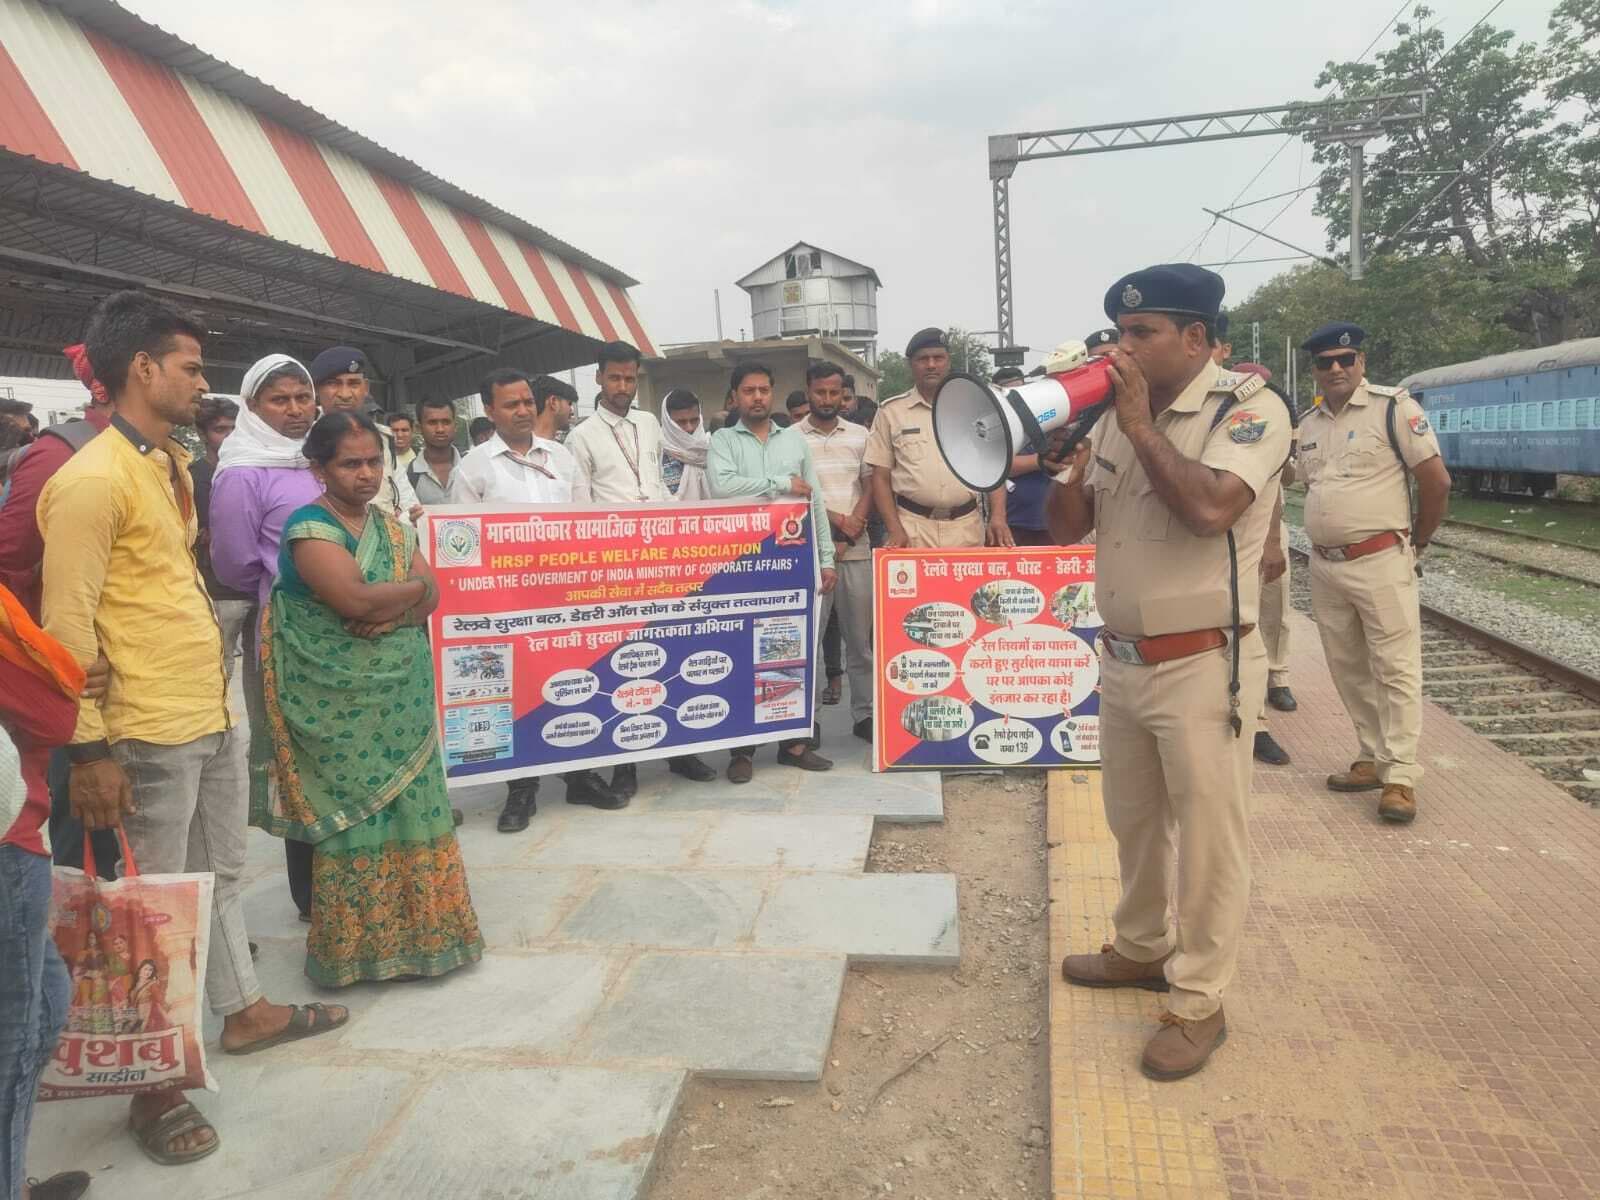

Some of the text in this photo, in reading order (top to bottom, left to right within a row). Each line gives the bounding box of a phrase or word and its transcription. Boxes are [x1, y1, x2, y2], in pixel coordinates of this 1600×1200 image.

[486, 516, 572, 543] मानवाधिकार
[574, 513, 637, 540] सामाजिक
[640, 516, 676, 544] सुरक्षा
[678, 515, 700, 535] जन
[702, 513, 748, 533] कल्याण
[751, 508, 771, 531] संघ
[491, 543, 761, 568] HRSP PEOPLE WELFARE ASSOCIATION
[458, 557, 792, 591] UNDER THE GOVERMENT OF INDIA MINISTRY OF CORPORATE AFFAIRS
[921, 558, 948, 577] रेलवे
[952, 561, 984, 582] सुरक्षा
[1016, 557, 1042, 575] पोस्ट
[565, 581, 704, 601] आपकी सेवा में सदैव तत्पर
[453, 617, 491, 631] रेलवे
[494, 614, 533, 633] सुरक्षा
[570, 607, 604, 622] डेहरी
[607, 603, 637, 618] ऑन
[640, 602, 668, 616] सोन
[671, 600, 686, 612] के
[689, 598, 730, 614] संयुक्त
[788, 591, 800, 603] में
[527, 635, 548, 652] रेल
[552, 631, 582, 649] यात्री
[585, 630, 624, 650] सुरक्षा
[694, 618, 744, 634] अभियान
[981, 636, 1078, 652] रेल नियमों का पालन
[969, 653, 1090, 672] करते हुए सुरक्षित यात्रा करें
[986, 672, 1073, 687] घर पर आपका कोई
[1023, 692, 1039, 703] कर
[1042, 692, 1057, 704] रहा
[1016, 742, 1028, 752] 139
